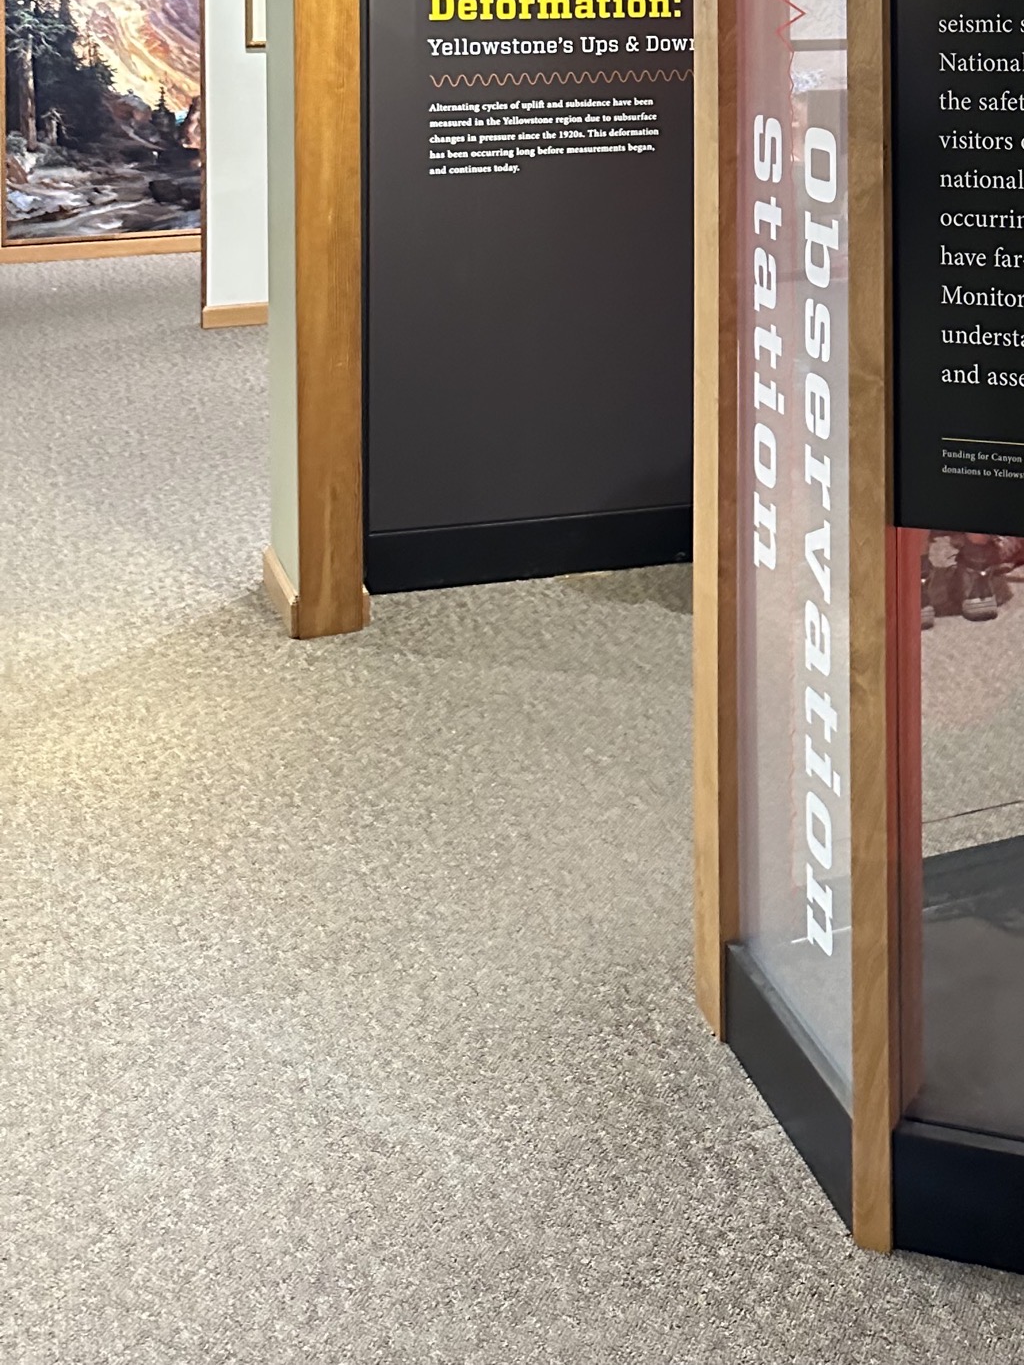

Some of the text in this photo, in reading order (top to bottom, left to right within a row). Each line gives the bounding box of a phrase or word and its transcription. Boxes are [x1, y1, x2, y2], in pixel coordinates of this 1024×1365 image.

[939, 14, 1012, 32] seismic
[427, 37, 573, 56] Yellowstone’s
[580, 37, 618, 55] Ups
[626, 36, 639, 51] &
[429, 97, 653, 113] Alternating cycles of uplift and subsidence have been
[940, 90, 971, 110] the
[430, 118, 472, 127] measured
[475, 118, 484, 126] in
[486, 117, 501, 125] the
[503, 116, 553, 125] Yellowstone
[556, 115, 582, 125] region
[585, 114, 600, 122] due
[614, 112, 657, 121] subsurface
[429, 128, 659, 145] changes in pressure since the 1920s. This deformation
[939, 130, 1013, 150] visitors
[429, 143, 655, 159] has been occurring long before measurements began,
[429, 163, 520, 175] and continues today.
[941, 169, 1024, 189] national
[941, 245, 986, 266] have
[753, 114, 785, 570] Station
[942, 364, 980, 384] and
[942, 450, 976, 462] Funding
[977, 453, 989, 461] for
[991, 454, 1022, 465] Canyon
[942, 465, 981, 475] donations
[804, 127, 841, 956] Observation
